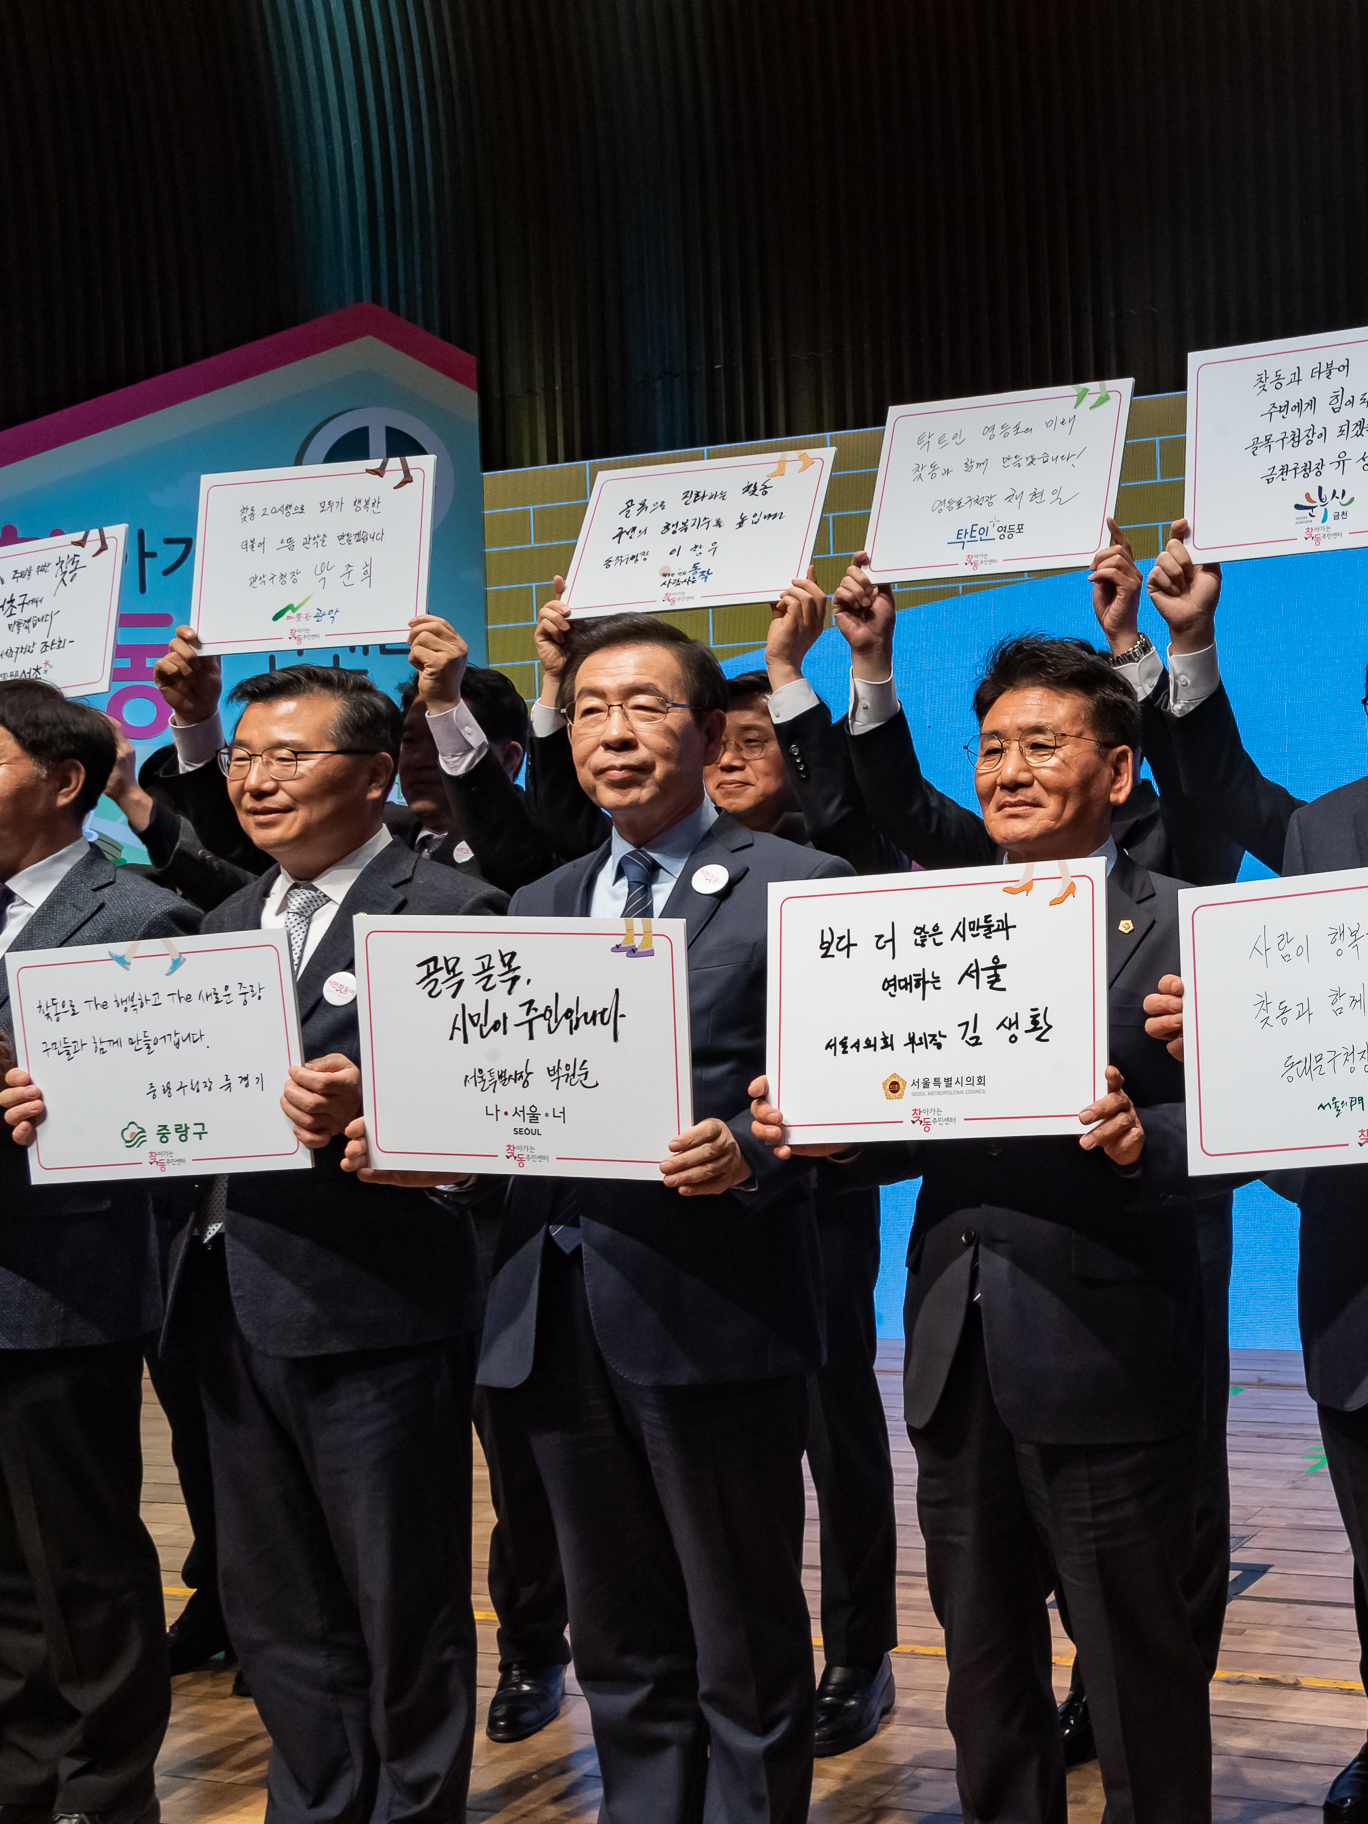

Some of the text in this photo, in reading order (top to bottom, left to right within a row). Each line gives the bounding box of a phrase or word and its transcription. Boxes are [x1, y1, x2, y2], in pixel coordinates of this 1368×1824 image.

[1254, 358, 1349, 396] 찾동과 더불어
[1329, 387, 1354, 413] 힘이
[917, 415, 1076, 452] 탁트인 영등포의 미래
[1245, 424, 1326, 456] 골목구청장이
[912, 462, 953, 482] 찾동과
[964, 458, 988, 475] 함께
[1261, 458, 1325, 484] 금천구청장
[240, 496, 381, 523] 찾동 모두가 행복한
[932, 494, 997, 513] 영등포구청장
[1333, 510, 1348, 520] 금천
[277, 537, 295, 551] 으뜸
[302, 534, 327, 549] 관악을
[947, 523, 1024, 550] 탁트인 영등포
[249, 569, 301, 588] 관악구청장
[313, 608, 340, 624] 관악
[819, 927, 857, 958] 보다
[875, 921, 895, 960] 더
[913, 923, 943, 948] 많은
[1249, 925, 1309, 968] 사람이
[416, 956, 464, 999] 골목
[882, 955, 1007, 1001] 연대하는 서울
[37, 983, 265, 1022] 찾동으로 The 행복하고 The 새로운 중랑
[1254, 991, 1313, 1029] 찾동과
[1329, 983, 1365, 1016] 함께
[449, 988, 626, 1044] 시민이 주인입니다
[42, 1037, 87, 1061] 구민들과
[93, 1036, 122, 1054] 함께
[825, 1031, 894, 1056] 서울시의회
[464, 1058, 599, 1093] 서울특별시장 박원순
[910, 1075, 986, 1089] 서울특별시의회
[156, 1122, 208, 1144] 중랑구
[514, 1127, 542, 1136] SEOUL
